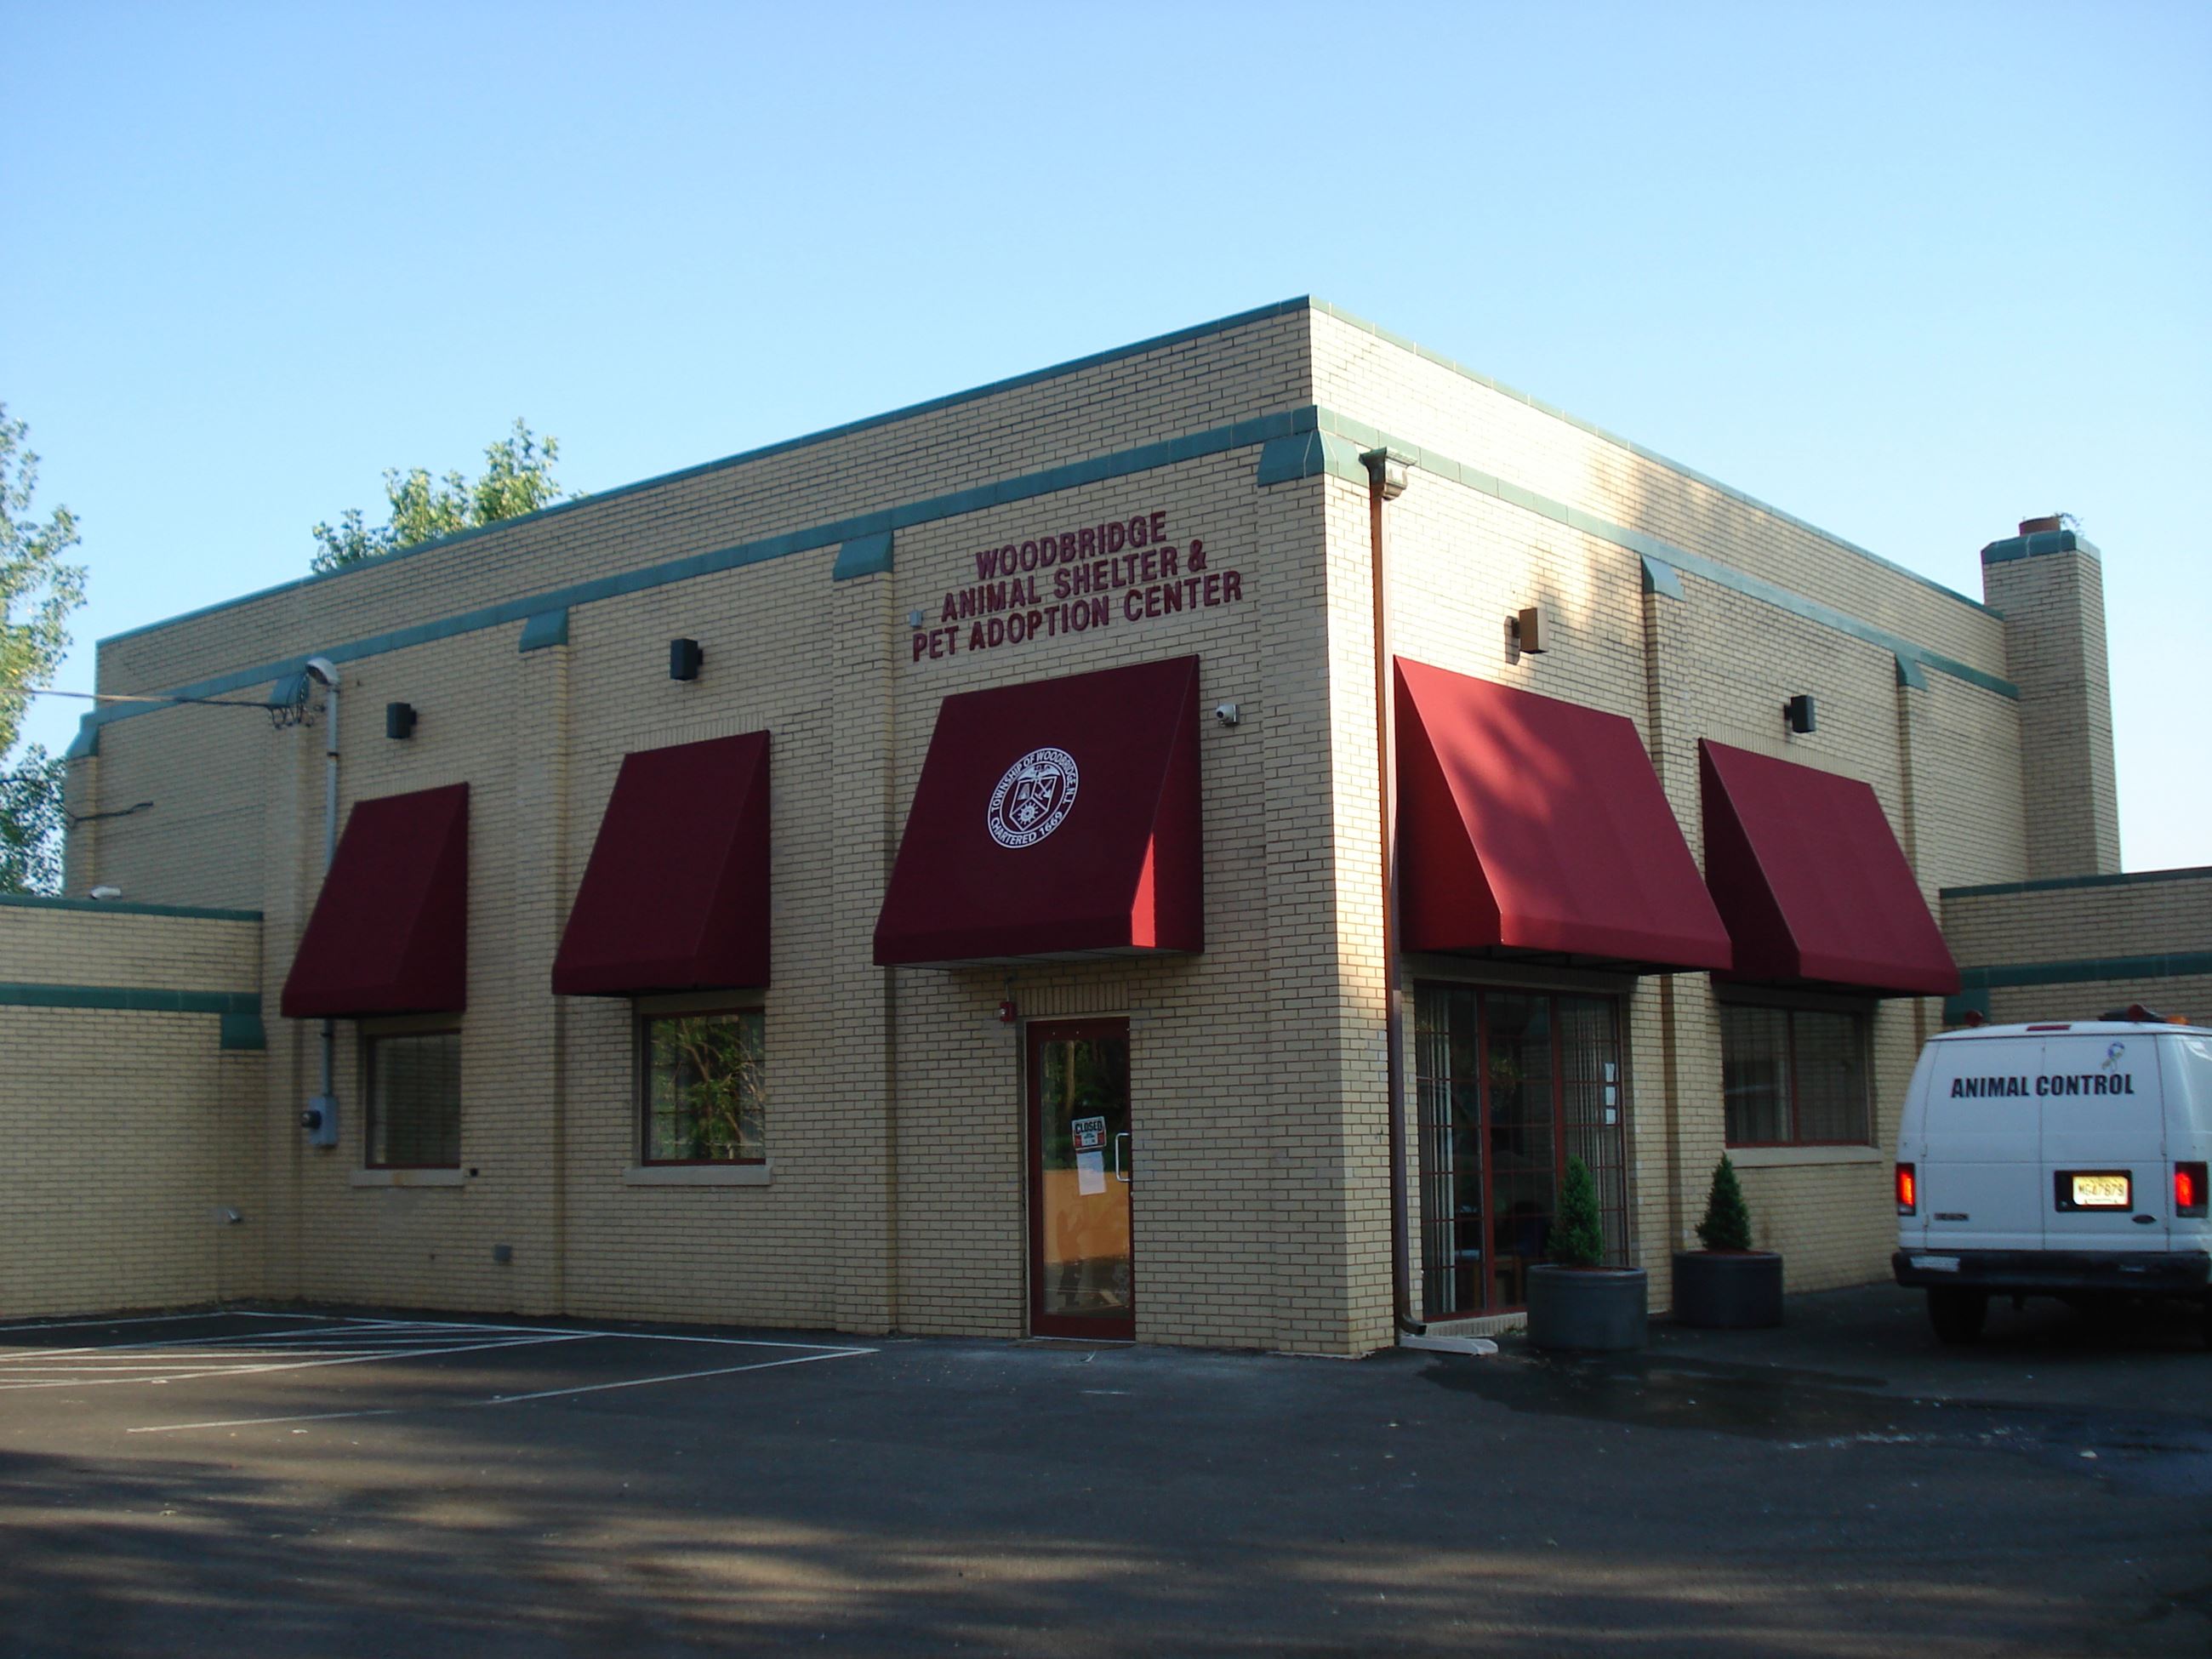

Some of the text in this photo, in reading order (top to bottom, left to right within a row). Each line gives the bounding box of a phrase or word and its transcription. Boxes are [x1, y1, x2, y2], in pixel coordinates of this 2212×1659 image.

[976, 510, 1166, 580] WOODBRIDGE
[941, 539, 1207, 622] ANIMAL SHELTER &
[913, 570, 1242, 662] PET ADOPTION CENTER
[991, 763, 1023, 812] TOWNSHIP
[1023, 755, 1035, 767] OF
[1036, 750, 1076, 786] WOODBRIDGE
[991, 811, 1063, 845] CHARTERED 1669
[1951, 1074, 2135, 1097] ANIMAL CONTROL
[1075, 1120, 1103, 1134] CLOSED
